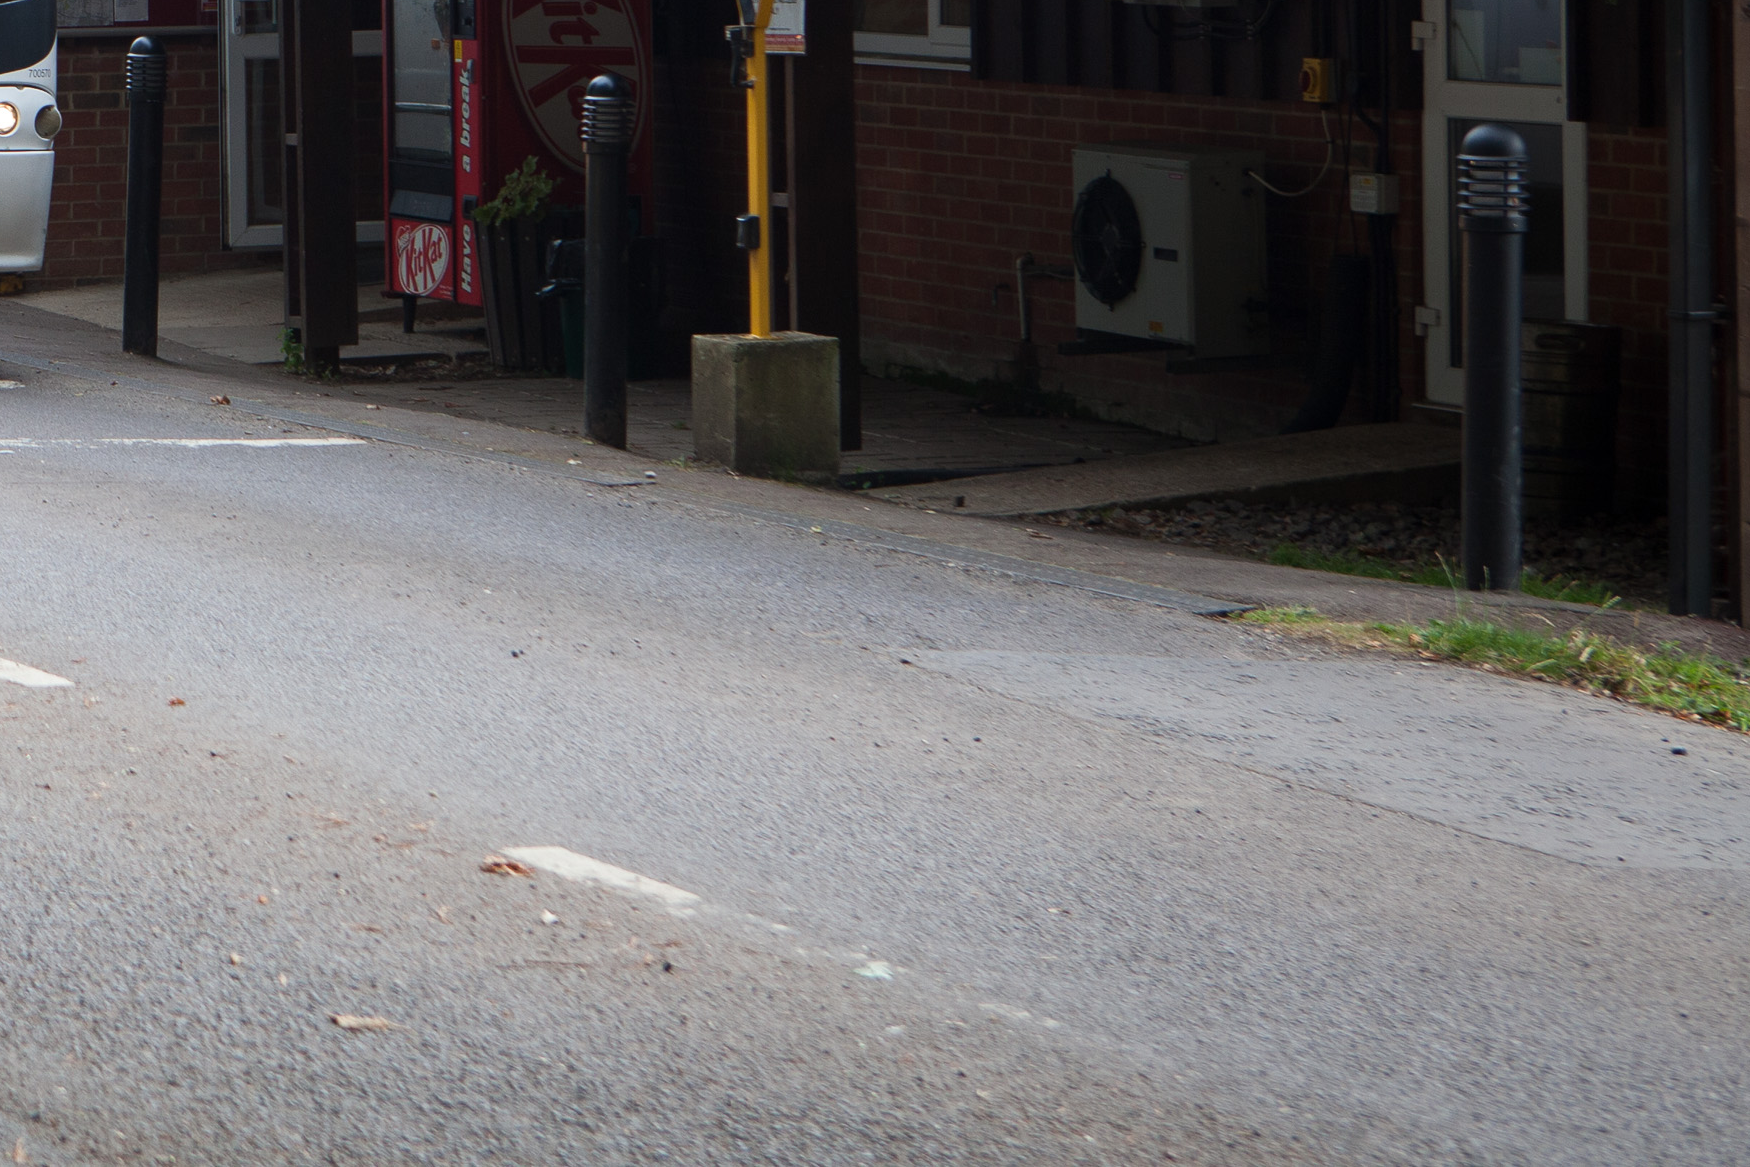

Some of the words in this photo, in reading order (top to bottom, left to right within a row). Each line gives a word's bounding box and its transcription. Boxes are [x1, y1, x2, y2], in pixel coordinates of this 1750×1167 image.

[462, 154, 471, 173] a
[405, 227, 443, 293] KitKat
[461, 224, 473, 293] Have
